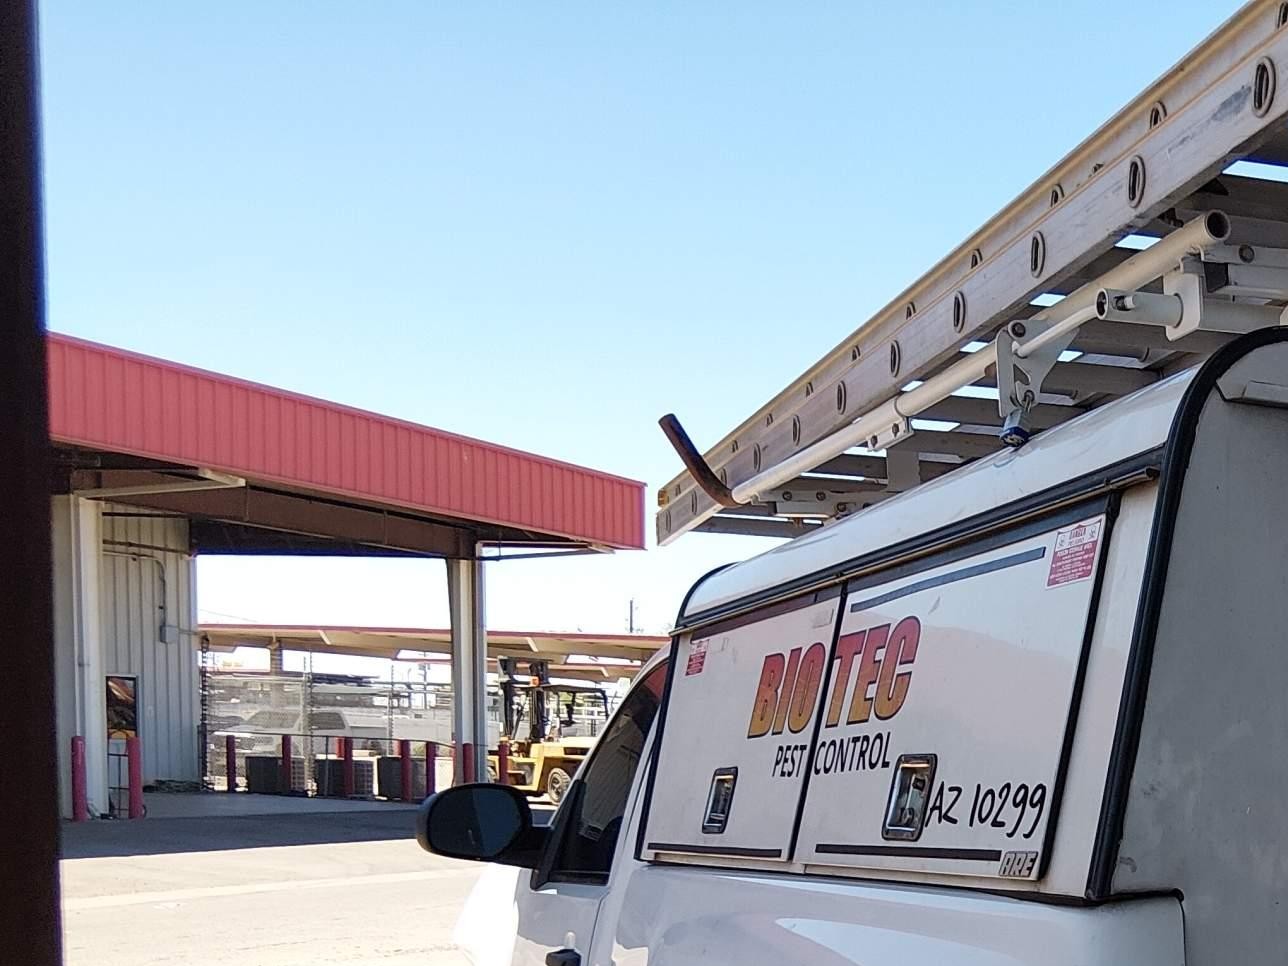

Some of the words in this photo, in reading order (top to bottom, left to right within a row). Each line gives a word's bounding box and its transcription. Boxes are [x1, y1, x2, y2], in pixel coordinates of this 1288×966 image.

[772, 744, 808, 778] PEST
[814, 731, 891, 775] CONTROL
[925, 781, 962, 827] AZ
[969, 782, 1047, 839] 10299
[999, 851, 1039, 878] ARE
